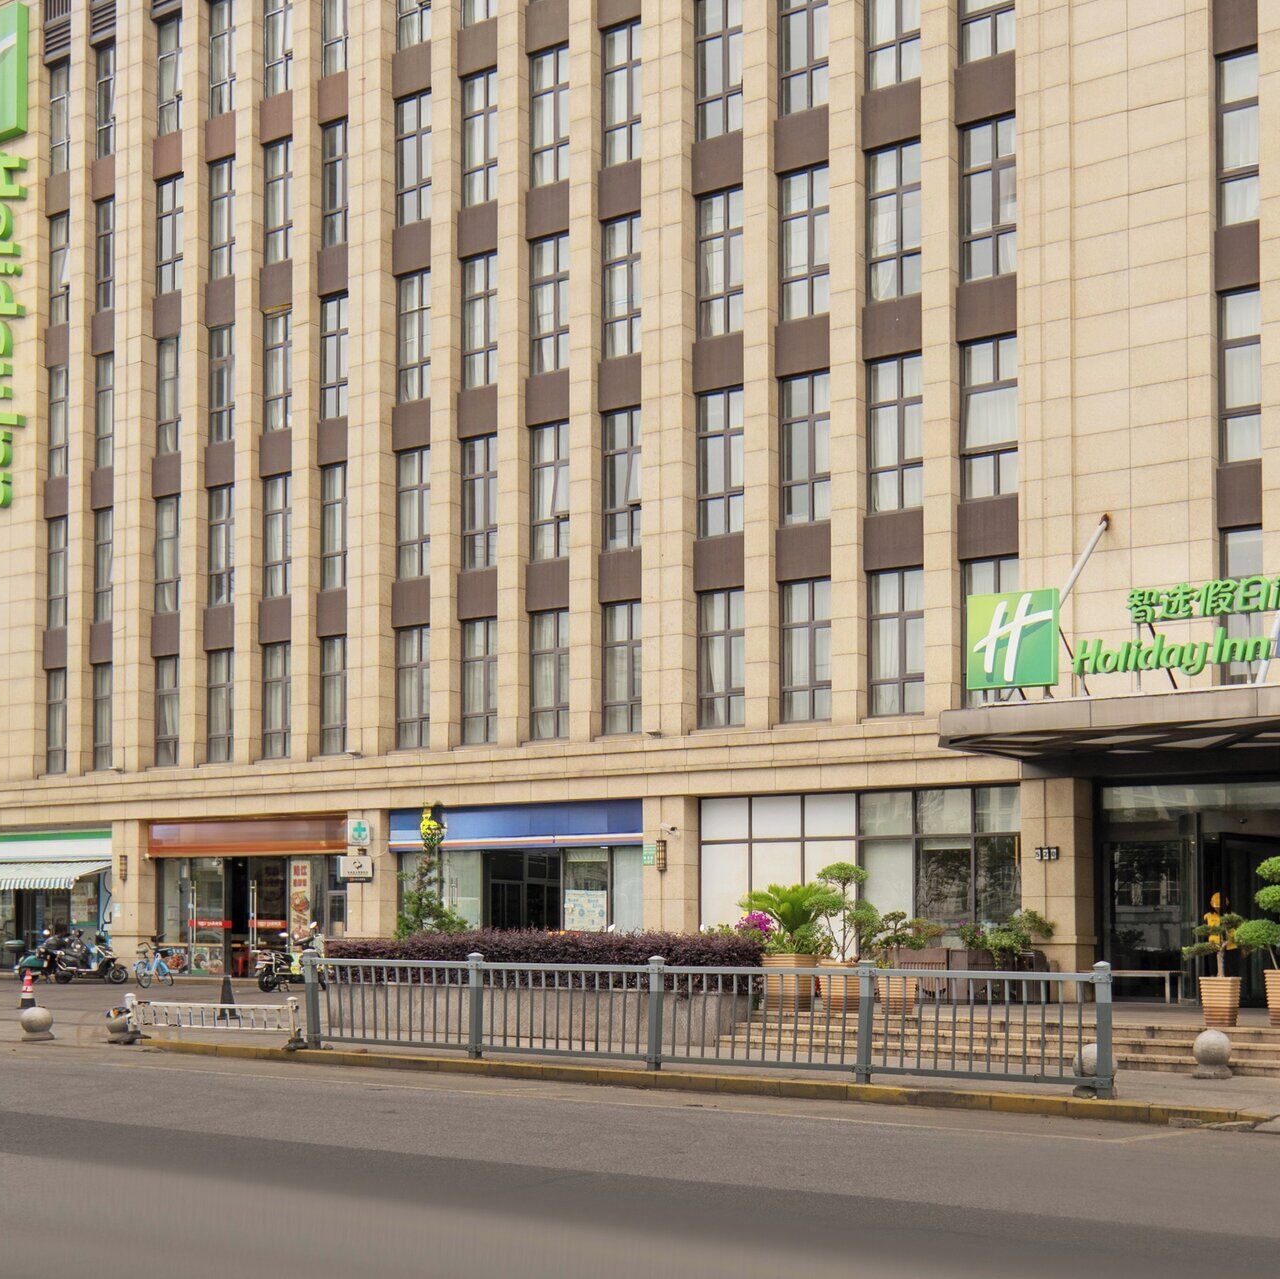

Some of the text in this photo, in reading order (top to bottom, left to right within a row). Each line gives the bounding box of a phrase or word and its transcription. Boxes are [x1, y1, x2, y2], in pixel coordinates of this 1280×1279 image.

[1071, 631, 1210, 677] Holiday
[1211, 625, 1272, 665] Inn
[1035, 850, 1056, 858] 520
